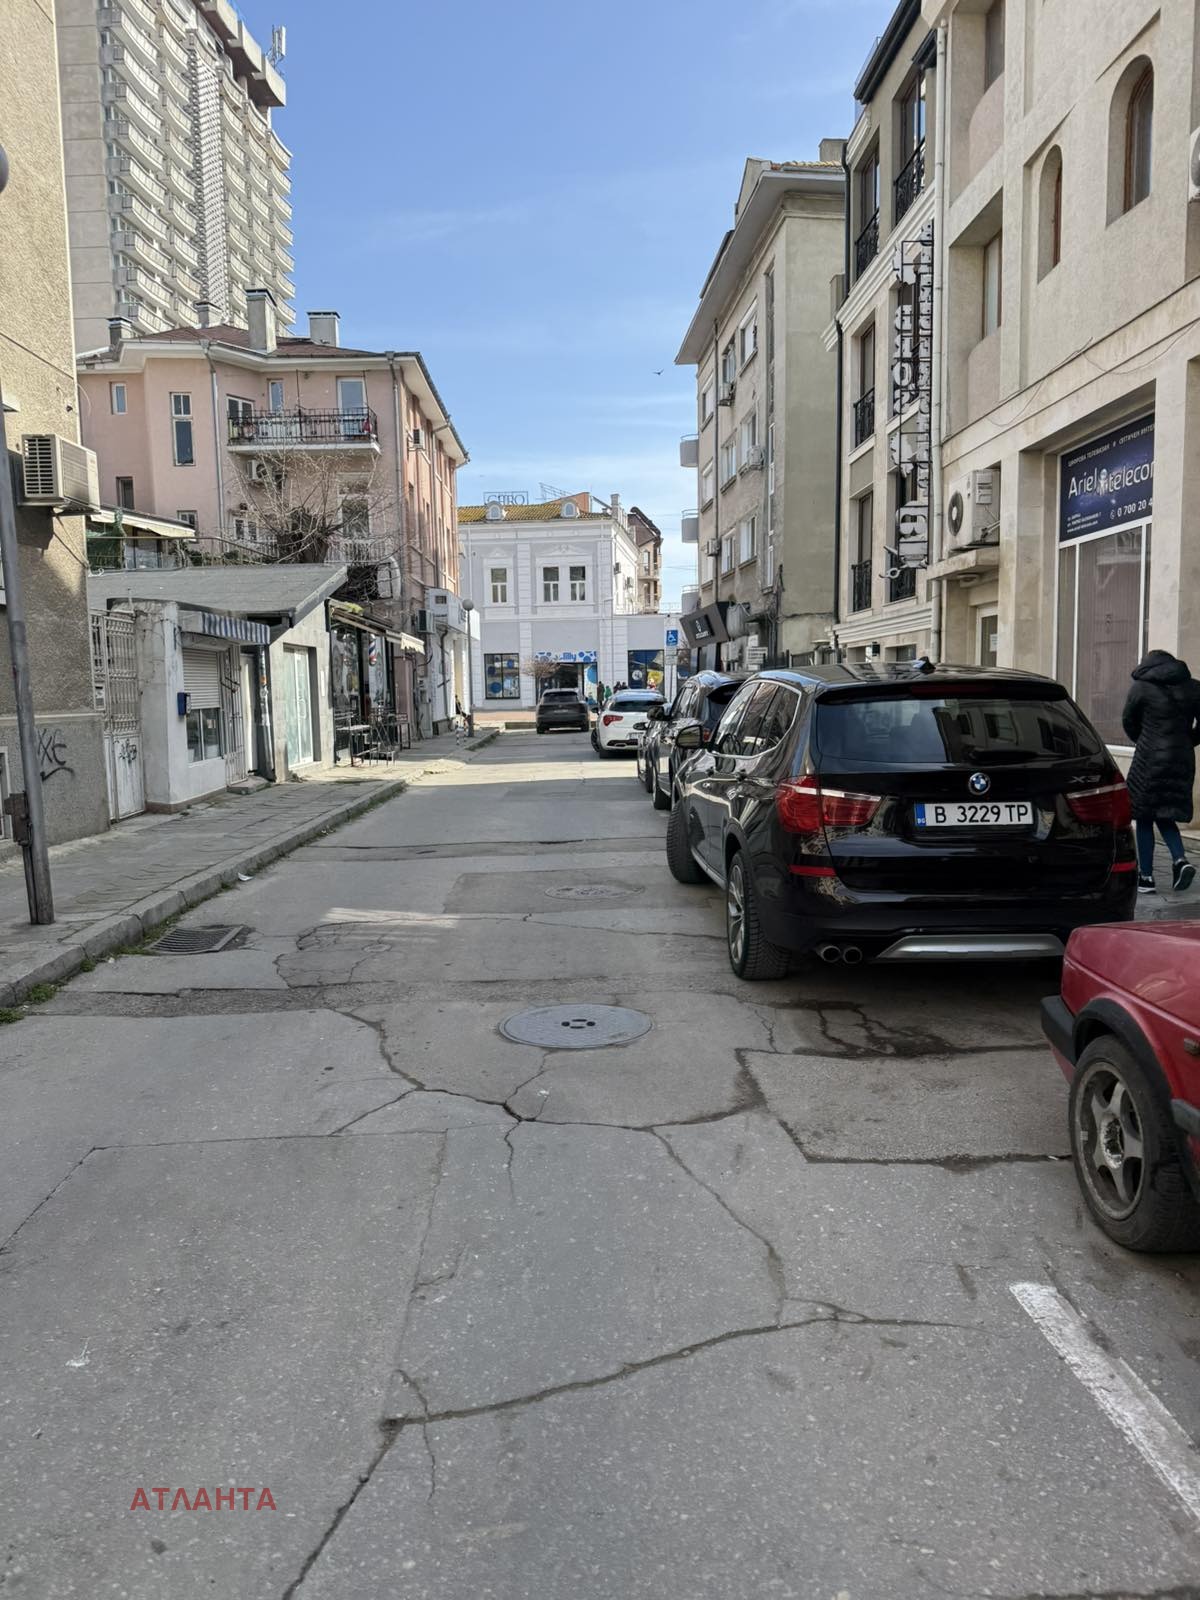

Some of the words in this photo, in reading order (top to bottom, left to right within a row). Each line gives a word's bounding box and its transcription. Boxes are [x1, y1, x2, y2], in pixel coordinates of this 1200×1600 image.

[1068, 467, 1098, 499] Ariel
[1123, 503, 1136, 516] 700
[1138, 500, 1147, 511] 20
[934, 806, 946, 824] B
[957, 805, 1001, 823] 3229
[1004, 804, 1028, 822] TP
